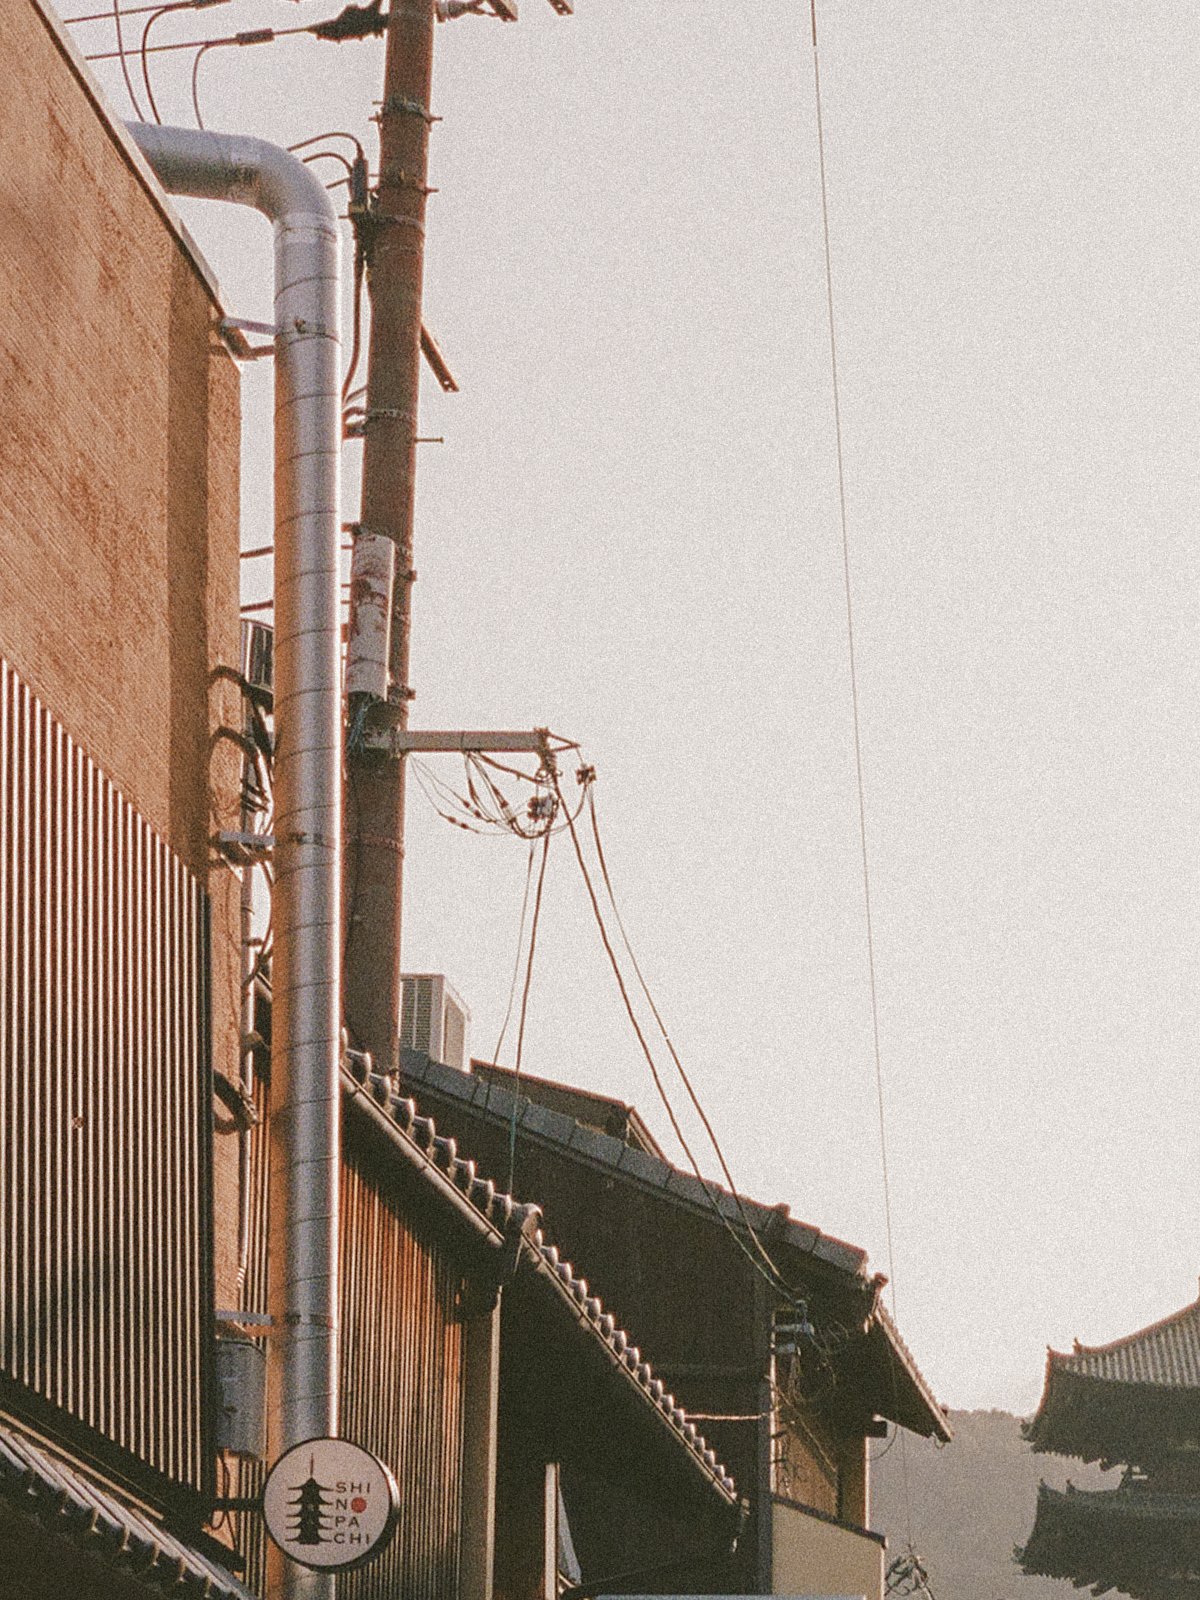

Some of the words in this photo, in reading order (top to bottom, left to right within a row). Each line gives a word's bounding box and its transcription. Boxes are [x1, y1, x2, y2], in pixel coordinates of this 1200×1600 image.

[336, 1482, 370, 1494] SHI
[335, 1499, 348, 1511] N
[335, 1516, 360, 1528] PA
[334, 1533, 370, 1544] CHI
